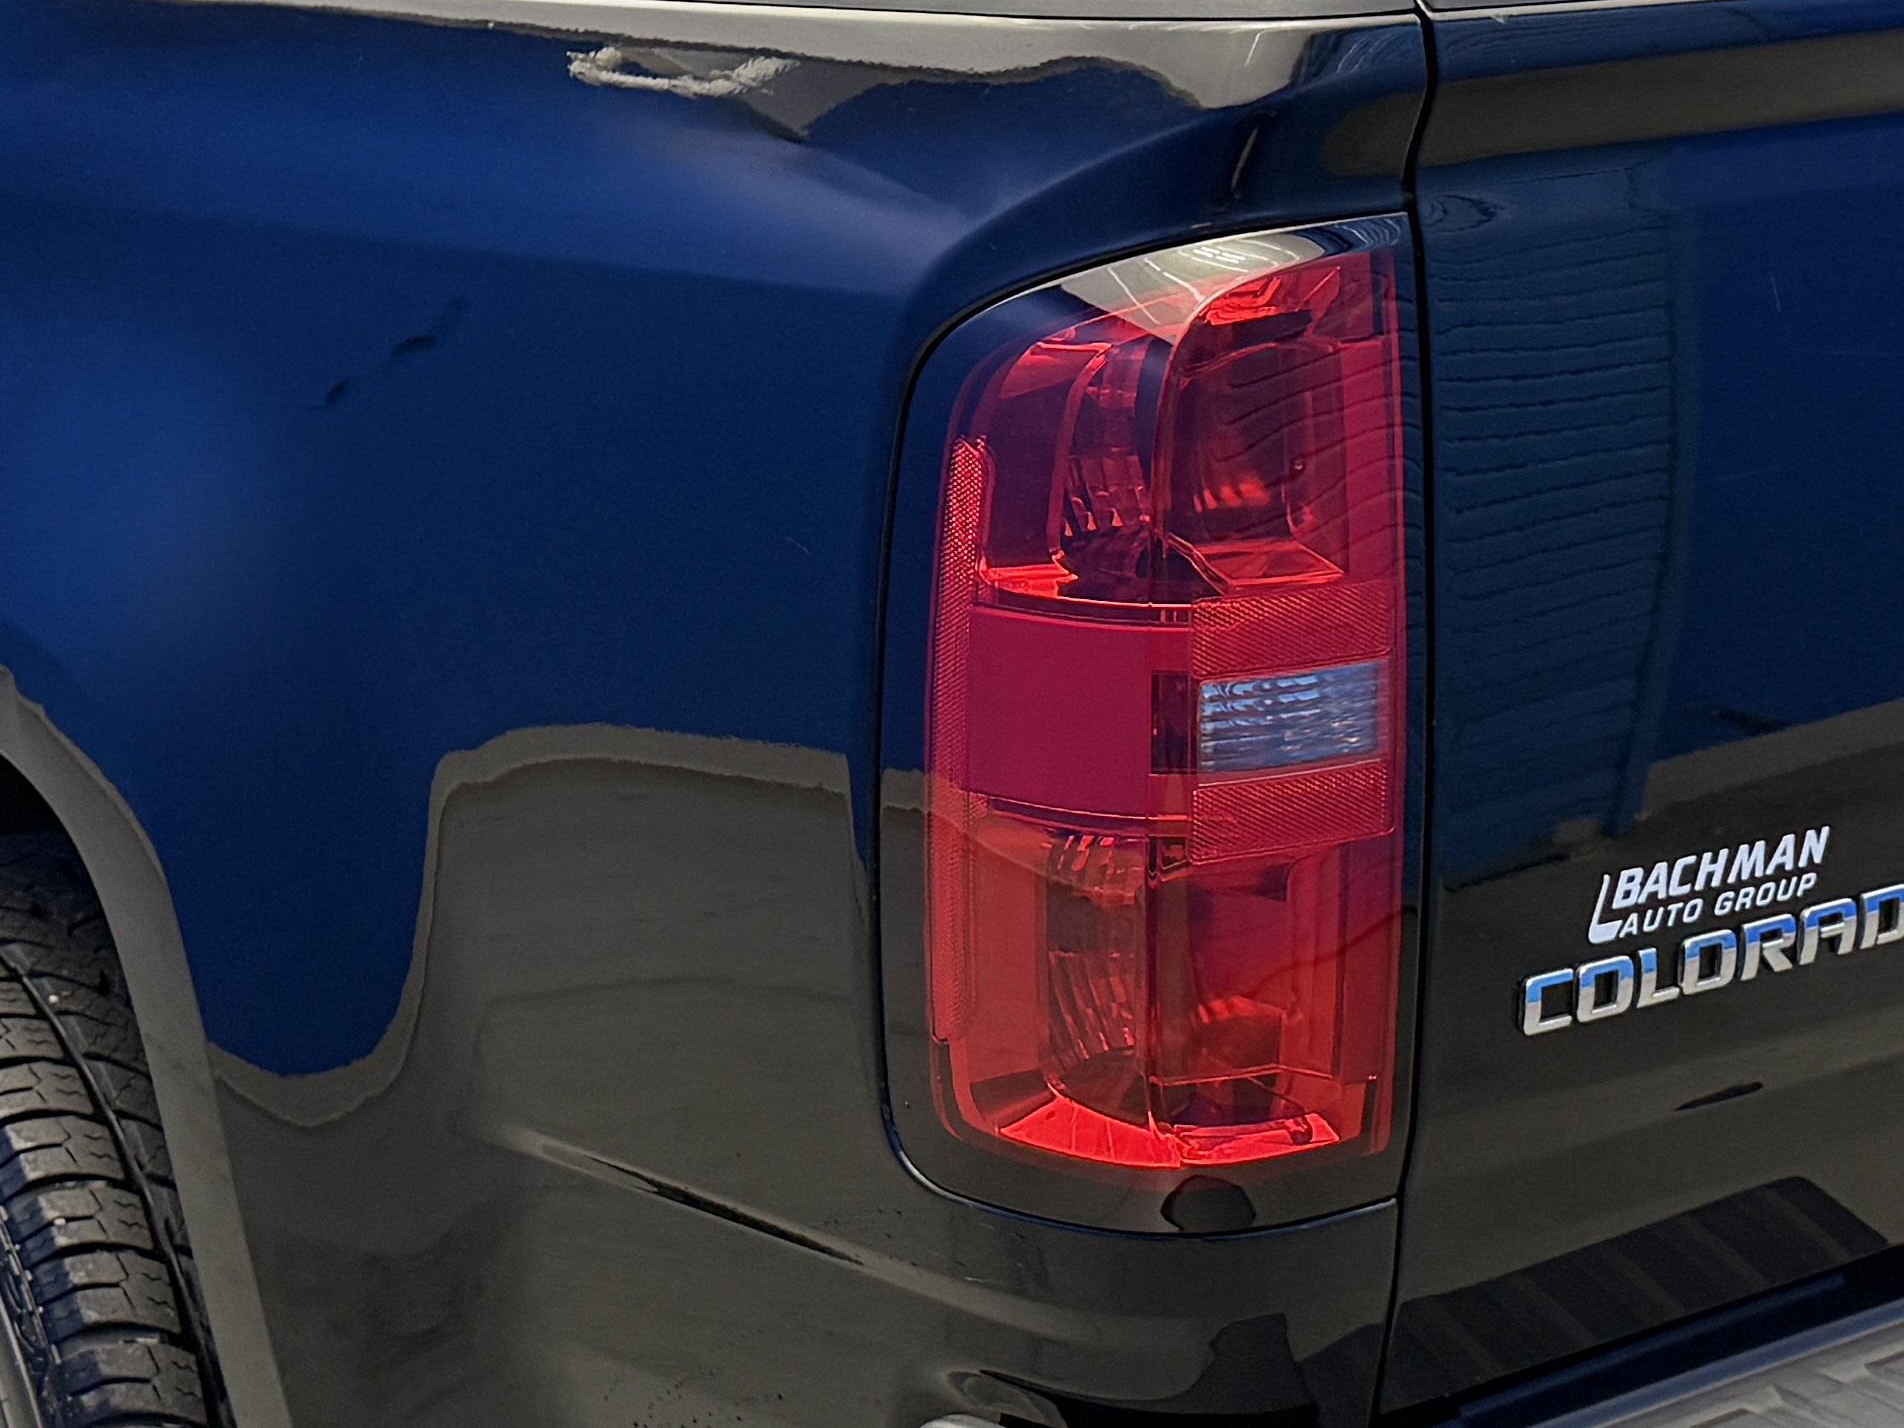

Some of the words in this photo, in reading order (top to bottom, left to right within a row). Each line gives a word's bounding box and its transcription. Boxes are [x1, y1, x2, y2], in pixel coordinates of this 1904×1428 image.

[1610, 825, 1831, 910] BACHMAN
[1618, 898, 1704, 940] AUTO
[1713, 871, 1818, 918] GROUP
